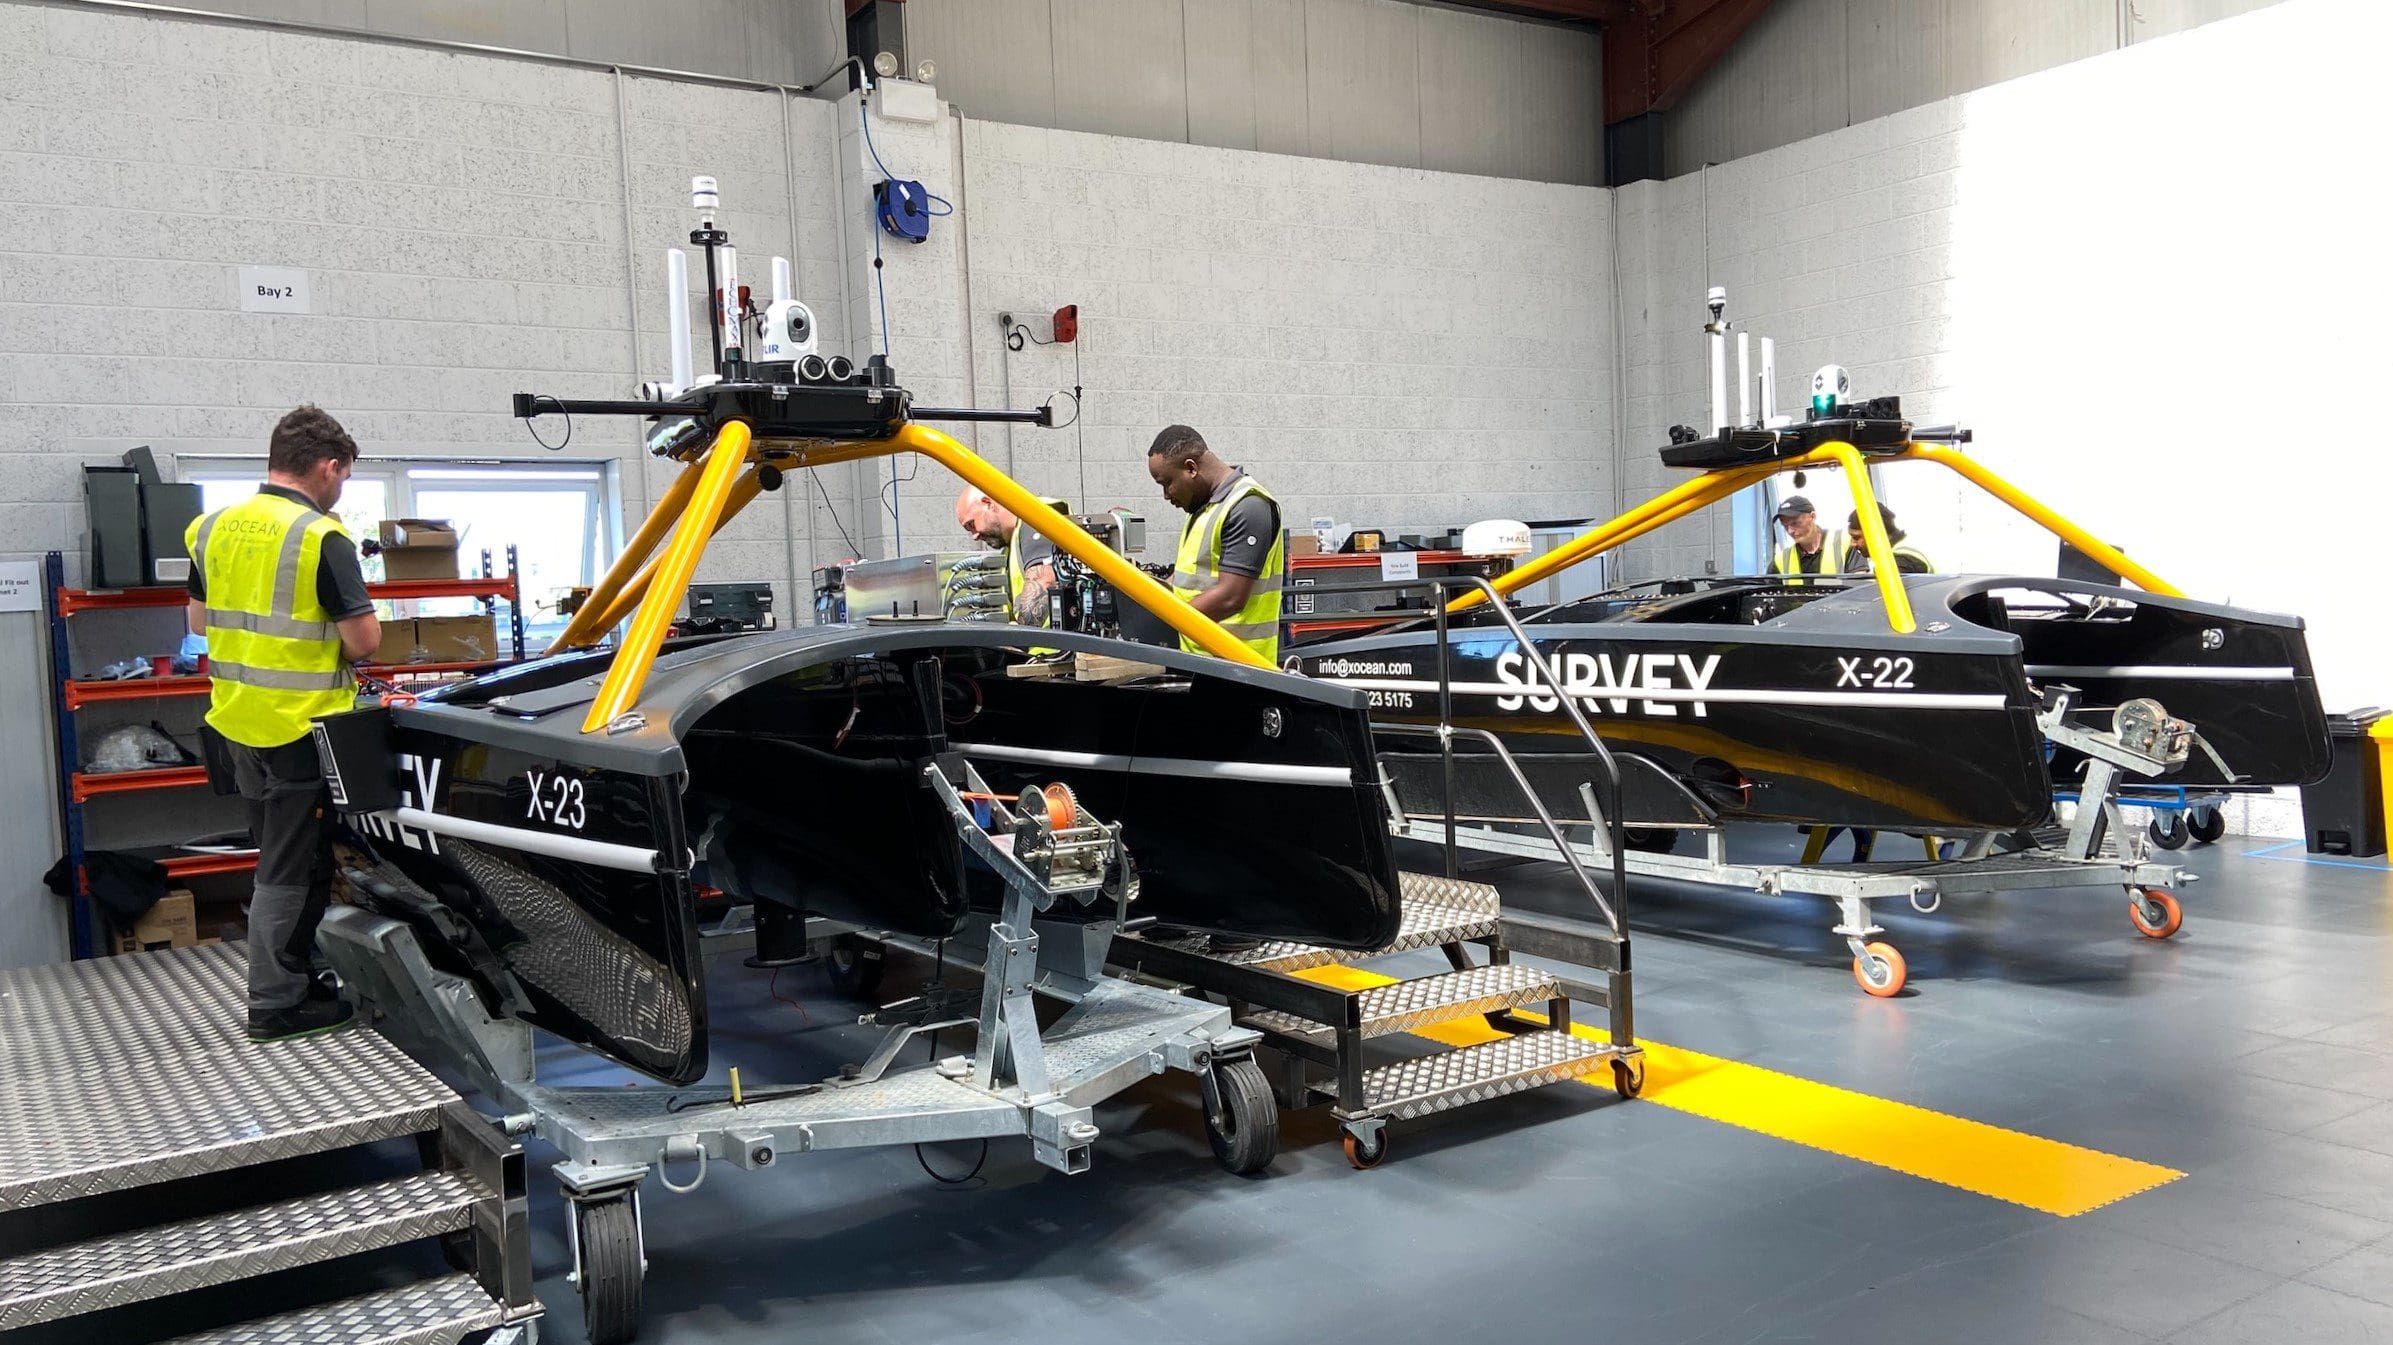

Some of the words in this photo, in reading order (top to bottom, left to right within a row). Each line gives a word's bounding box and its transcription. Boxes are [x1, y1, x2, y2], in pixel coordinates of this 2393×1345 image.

[257, 285, 281, 299] Bay
[285, 287, 293, 297] 2
[763, 344, 779, 354] LIR
[1319, 658, 1412, 677] info@xocean.com
[1836, 656, 1916, 689] X-22
[1496, 651, 1722, 718] SURVEY
[1384, 691, 1413, 708] 5175
[526, 770, 586, 829] X-23
